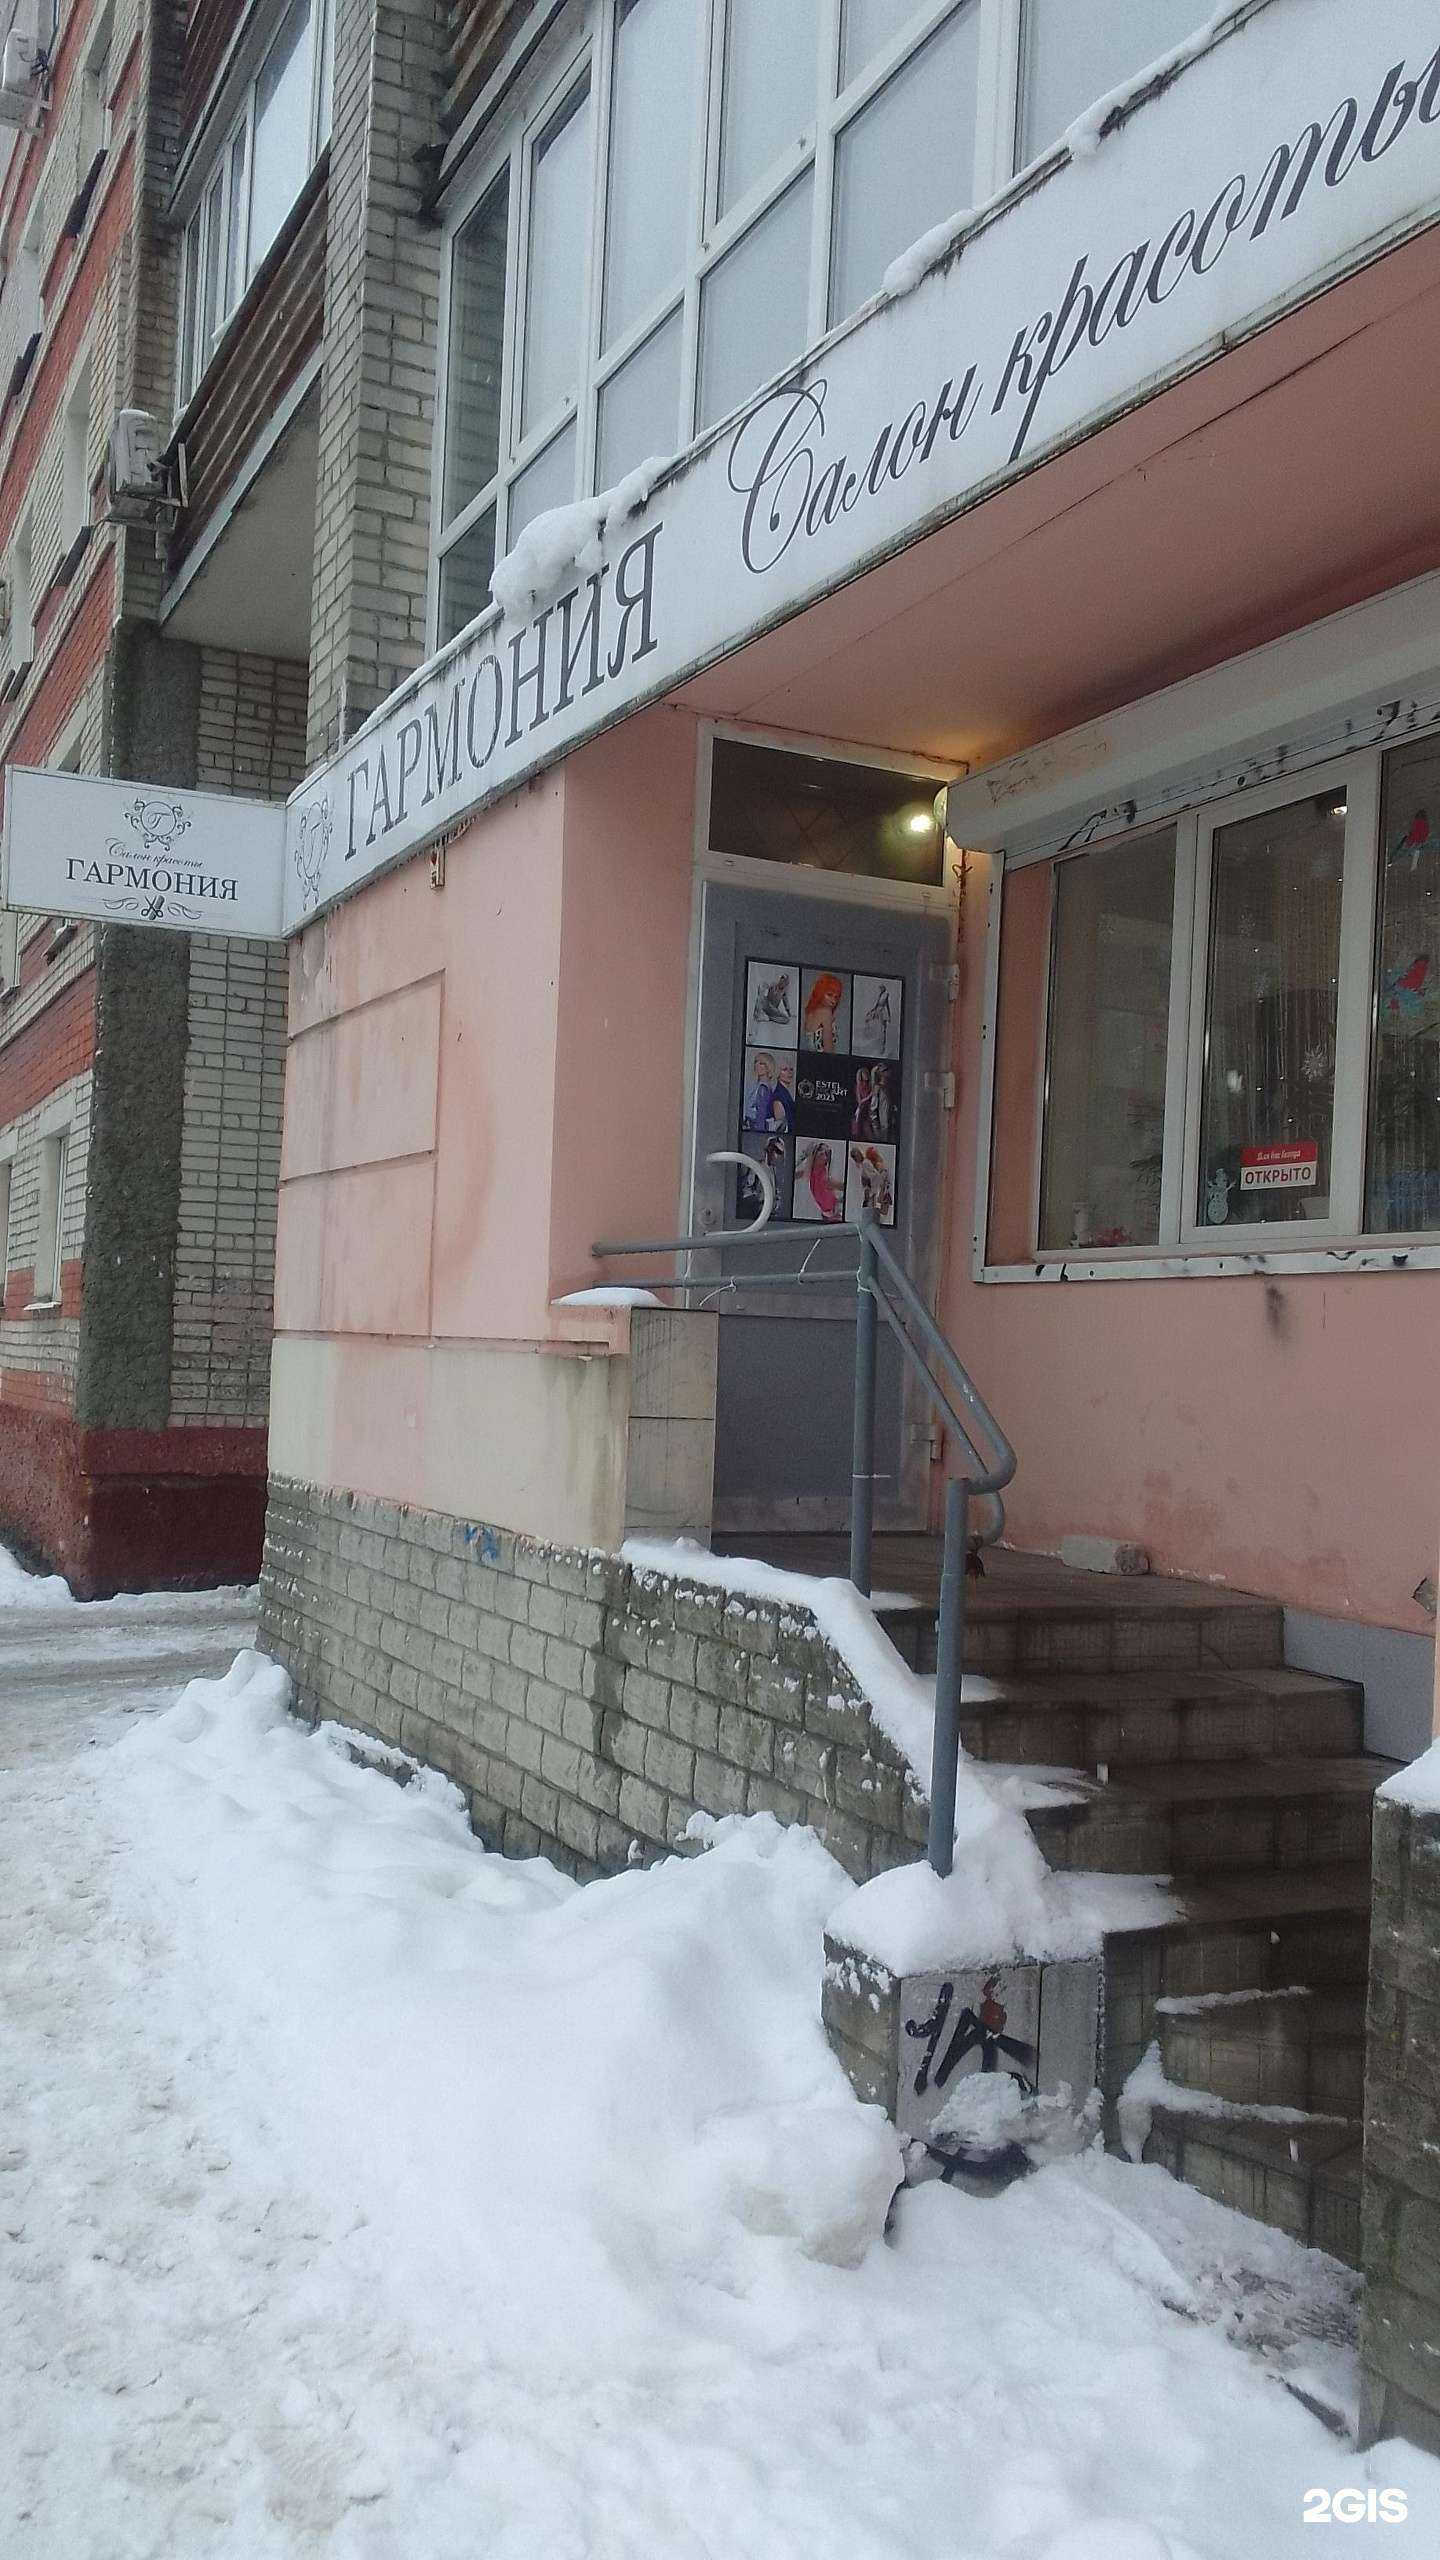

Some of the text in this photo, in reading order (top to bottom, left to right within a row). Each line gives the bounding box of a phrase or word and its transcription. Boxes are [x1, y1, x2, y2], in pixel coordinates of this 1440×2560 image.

[344, 44, 1440, 861] ГАРМОНИЯ Салон красоты
[105, 837, 151, 861] Салон
[65, 858, 239, 901] ГАРМОНИЯ
[1245, 1167, 1311, 1184] ОТКРЫТО
